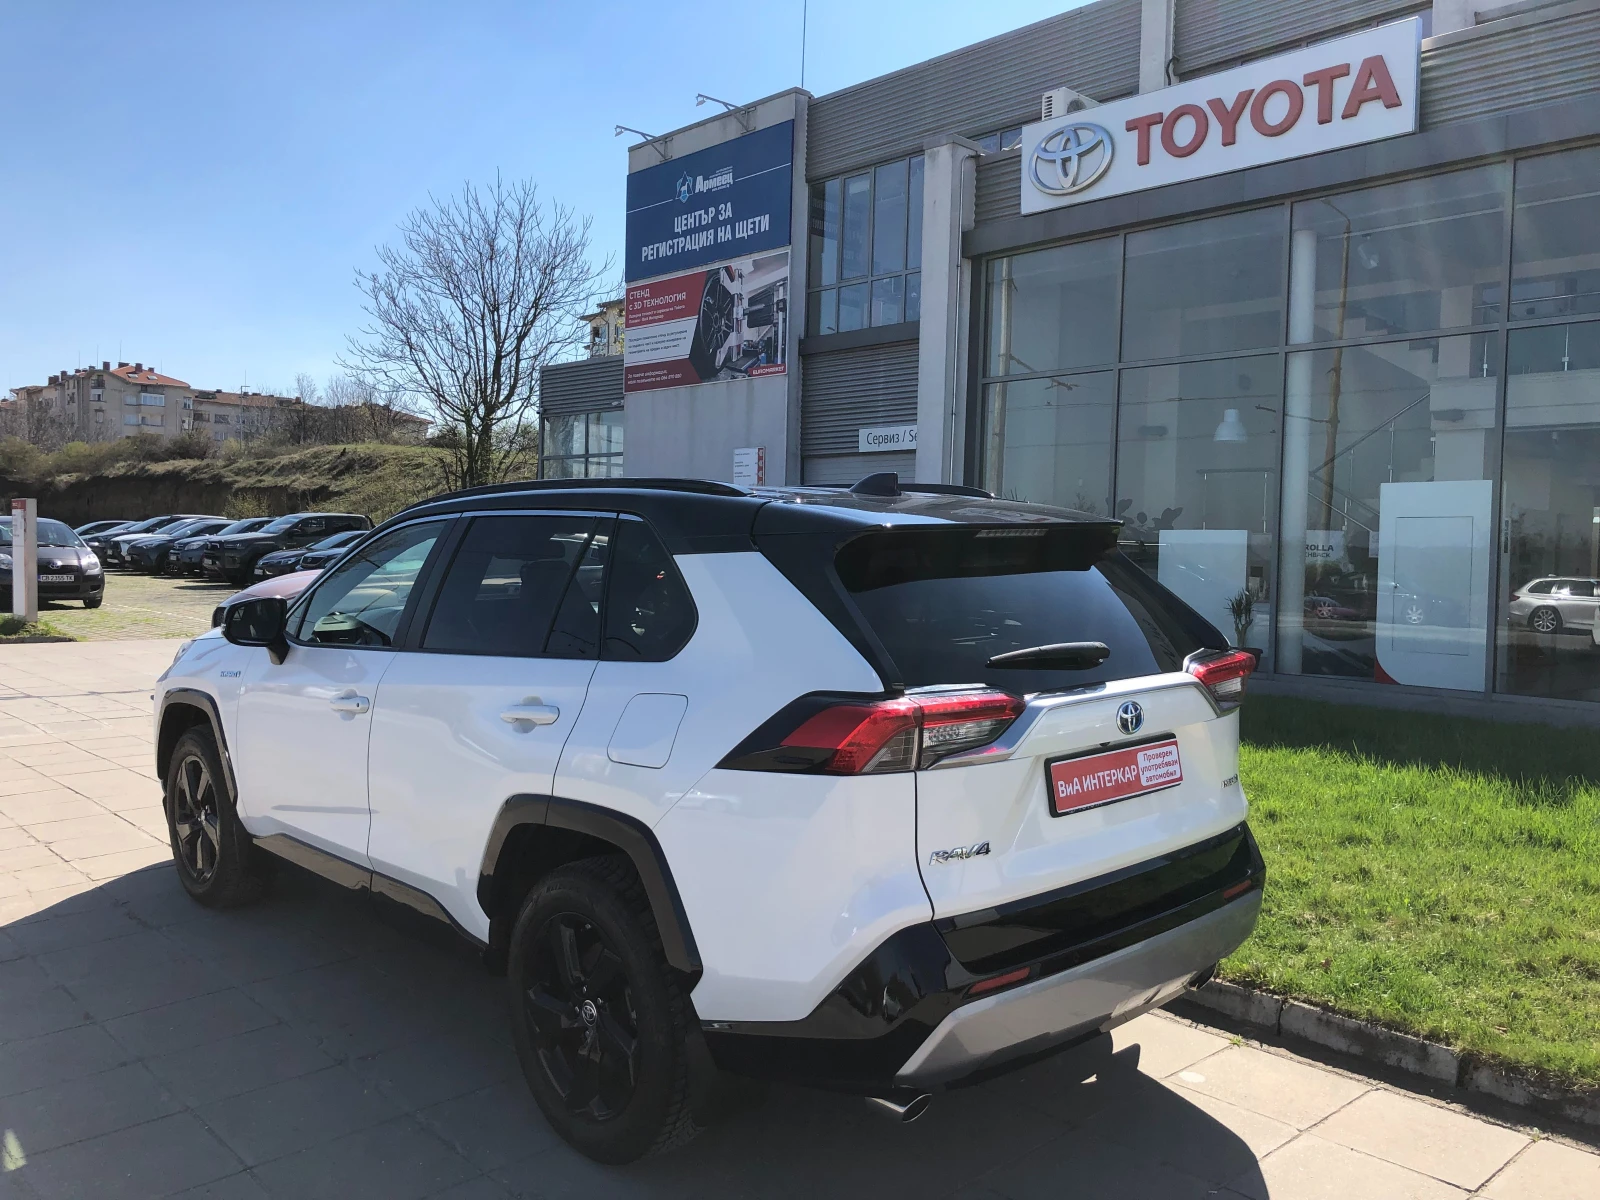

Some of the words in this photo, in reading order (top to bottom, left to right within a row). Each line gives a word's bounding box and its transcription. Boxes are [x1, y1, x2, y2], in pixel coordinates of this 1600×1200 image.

[1125, 54, 1402, 167] TOYOTA
[695, 172, 733, 193] Армеец
[674, 207, 716, 235] ЦЕНТЪР
[718, 201, 733, 221] ЗА
[641, 229, 715, 262] РЕГИСТРАЦИЯ
[717, 224, 732, 243] НА
[735, 214, 770, 240] ЩЕТИ
[629, 288, 650, 300] СТЕНД
[633, 301, 642, 310] 3D
[643, 292, 687, 308] ТЕХНОЛОГИЯ
[752, 366, 784, 375] EUROMARKET
[866, 432, 900, 447] Сервиз
[901, 429, 907, 443] /
[1142, 749, 1173, 762] Проверен
[1140, 758, 1179, 775] употребяван
[1057, 776, 1082, 798] ВиА
[1082, 764, 1138, 792] ИНТЕРКАР
[1145, 769, 1177, 783] автомобил
[929, 840, 991, 866] RAV4
